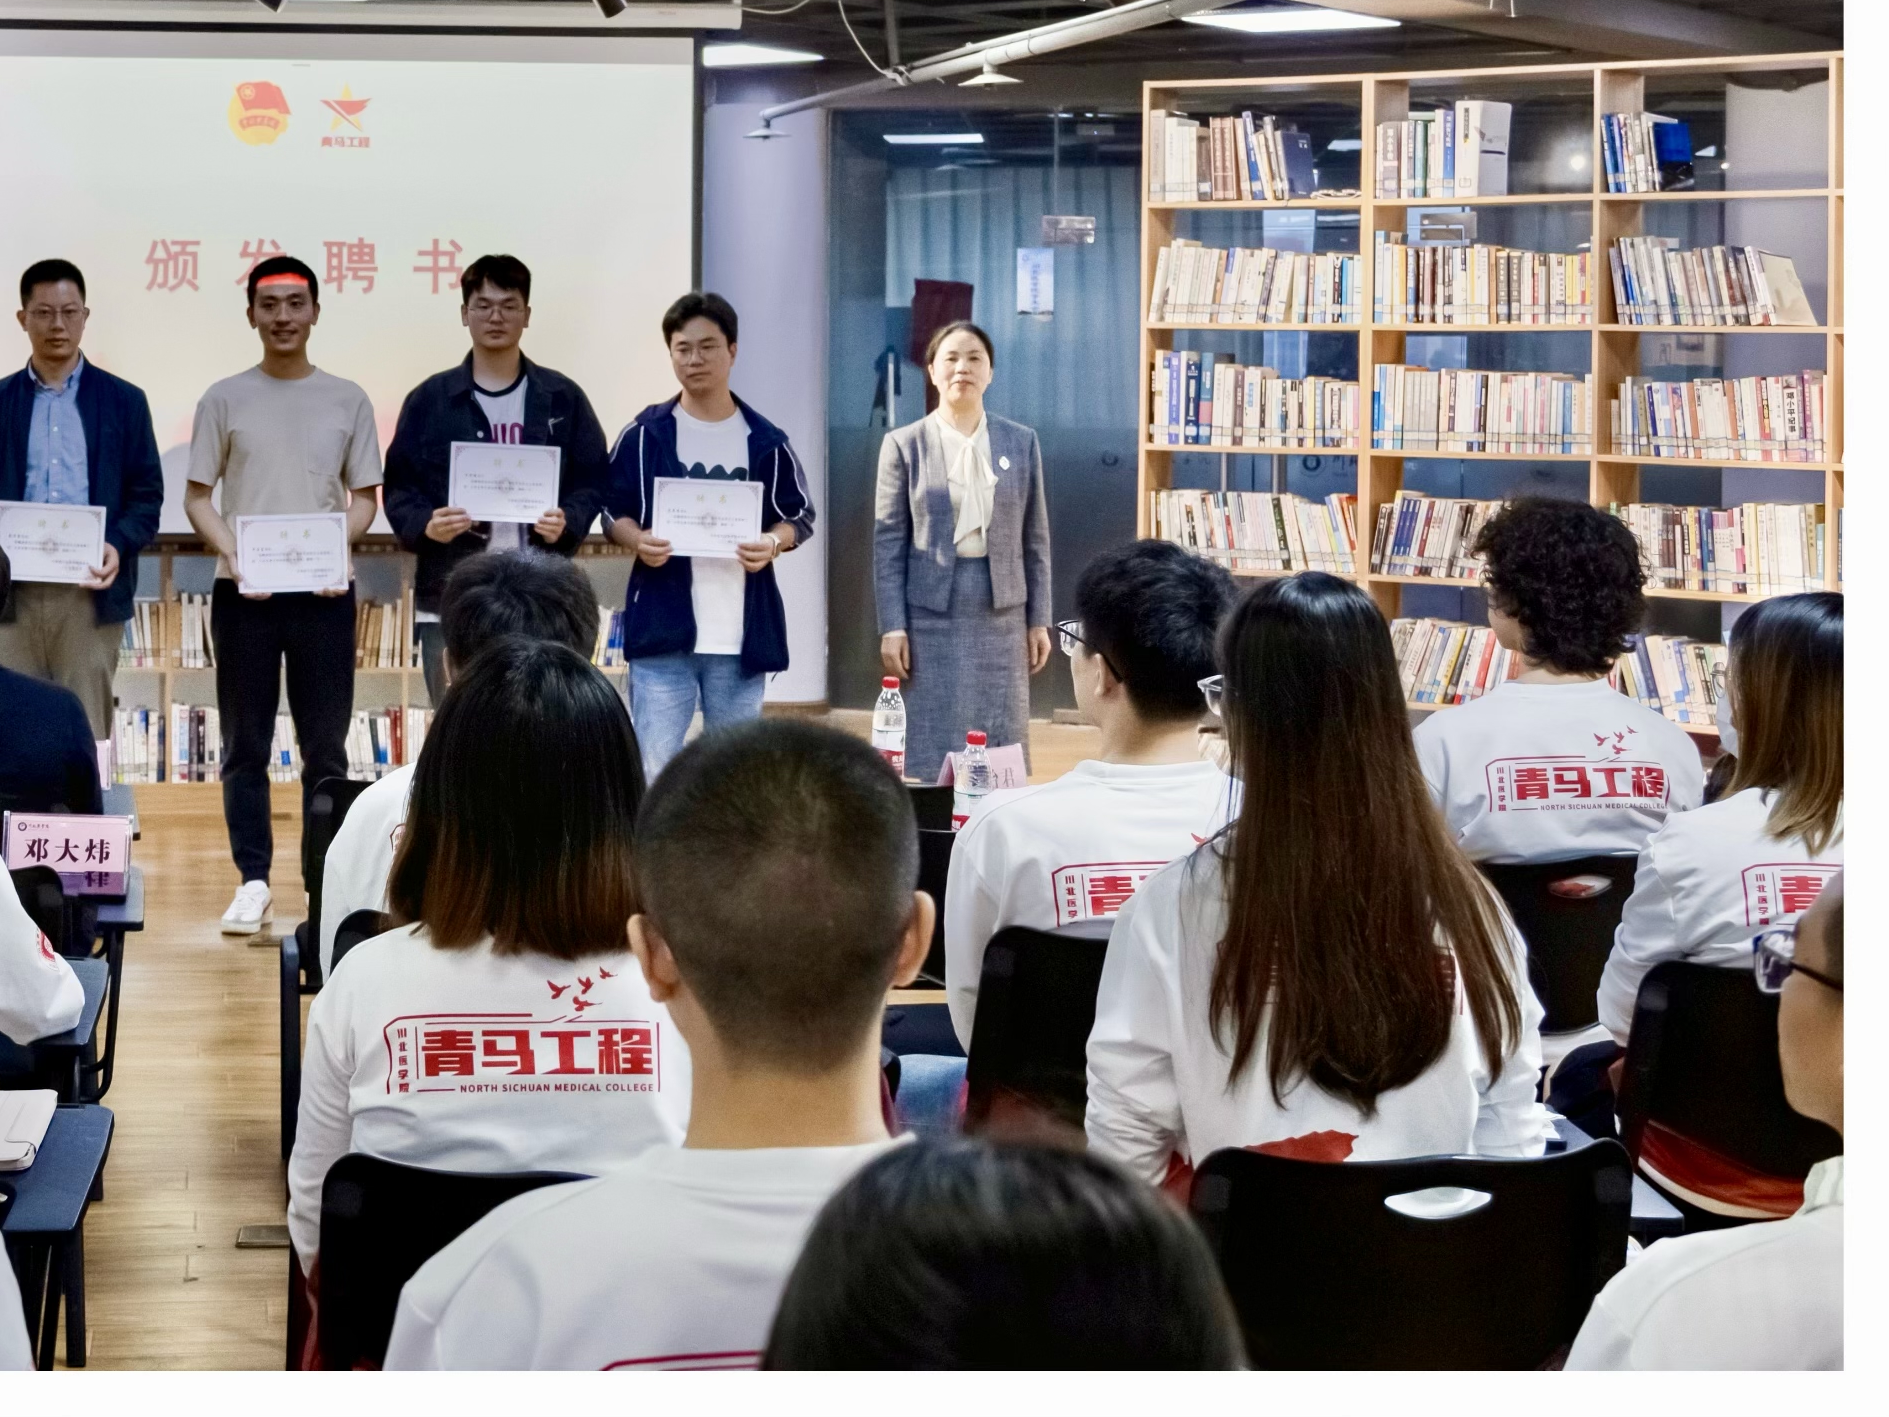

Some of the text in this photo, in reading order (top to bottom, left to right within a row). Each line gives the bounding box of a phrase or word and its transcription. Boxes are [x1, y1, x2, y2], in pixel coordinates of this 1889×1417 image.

[1514, 766, 1665, 801] 青马工程
[24, 838, 111, 865] 邓大炜
[396, 1028, 410, 1094] 川北医学院
[421, 1028, 654, 1077] 青马工程
[460, 1084, 654, 1093] NORTH SICHUAN MEDICAL COLLEGE
